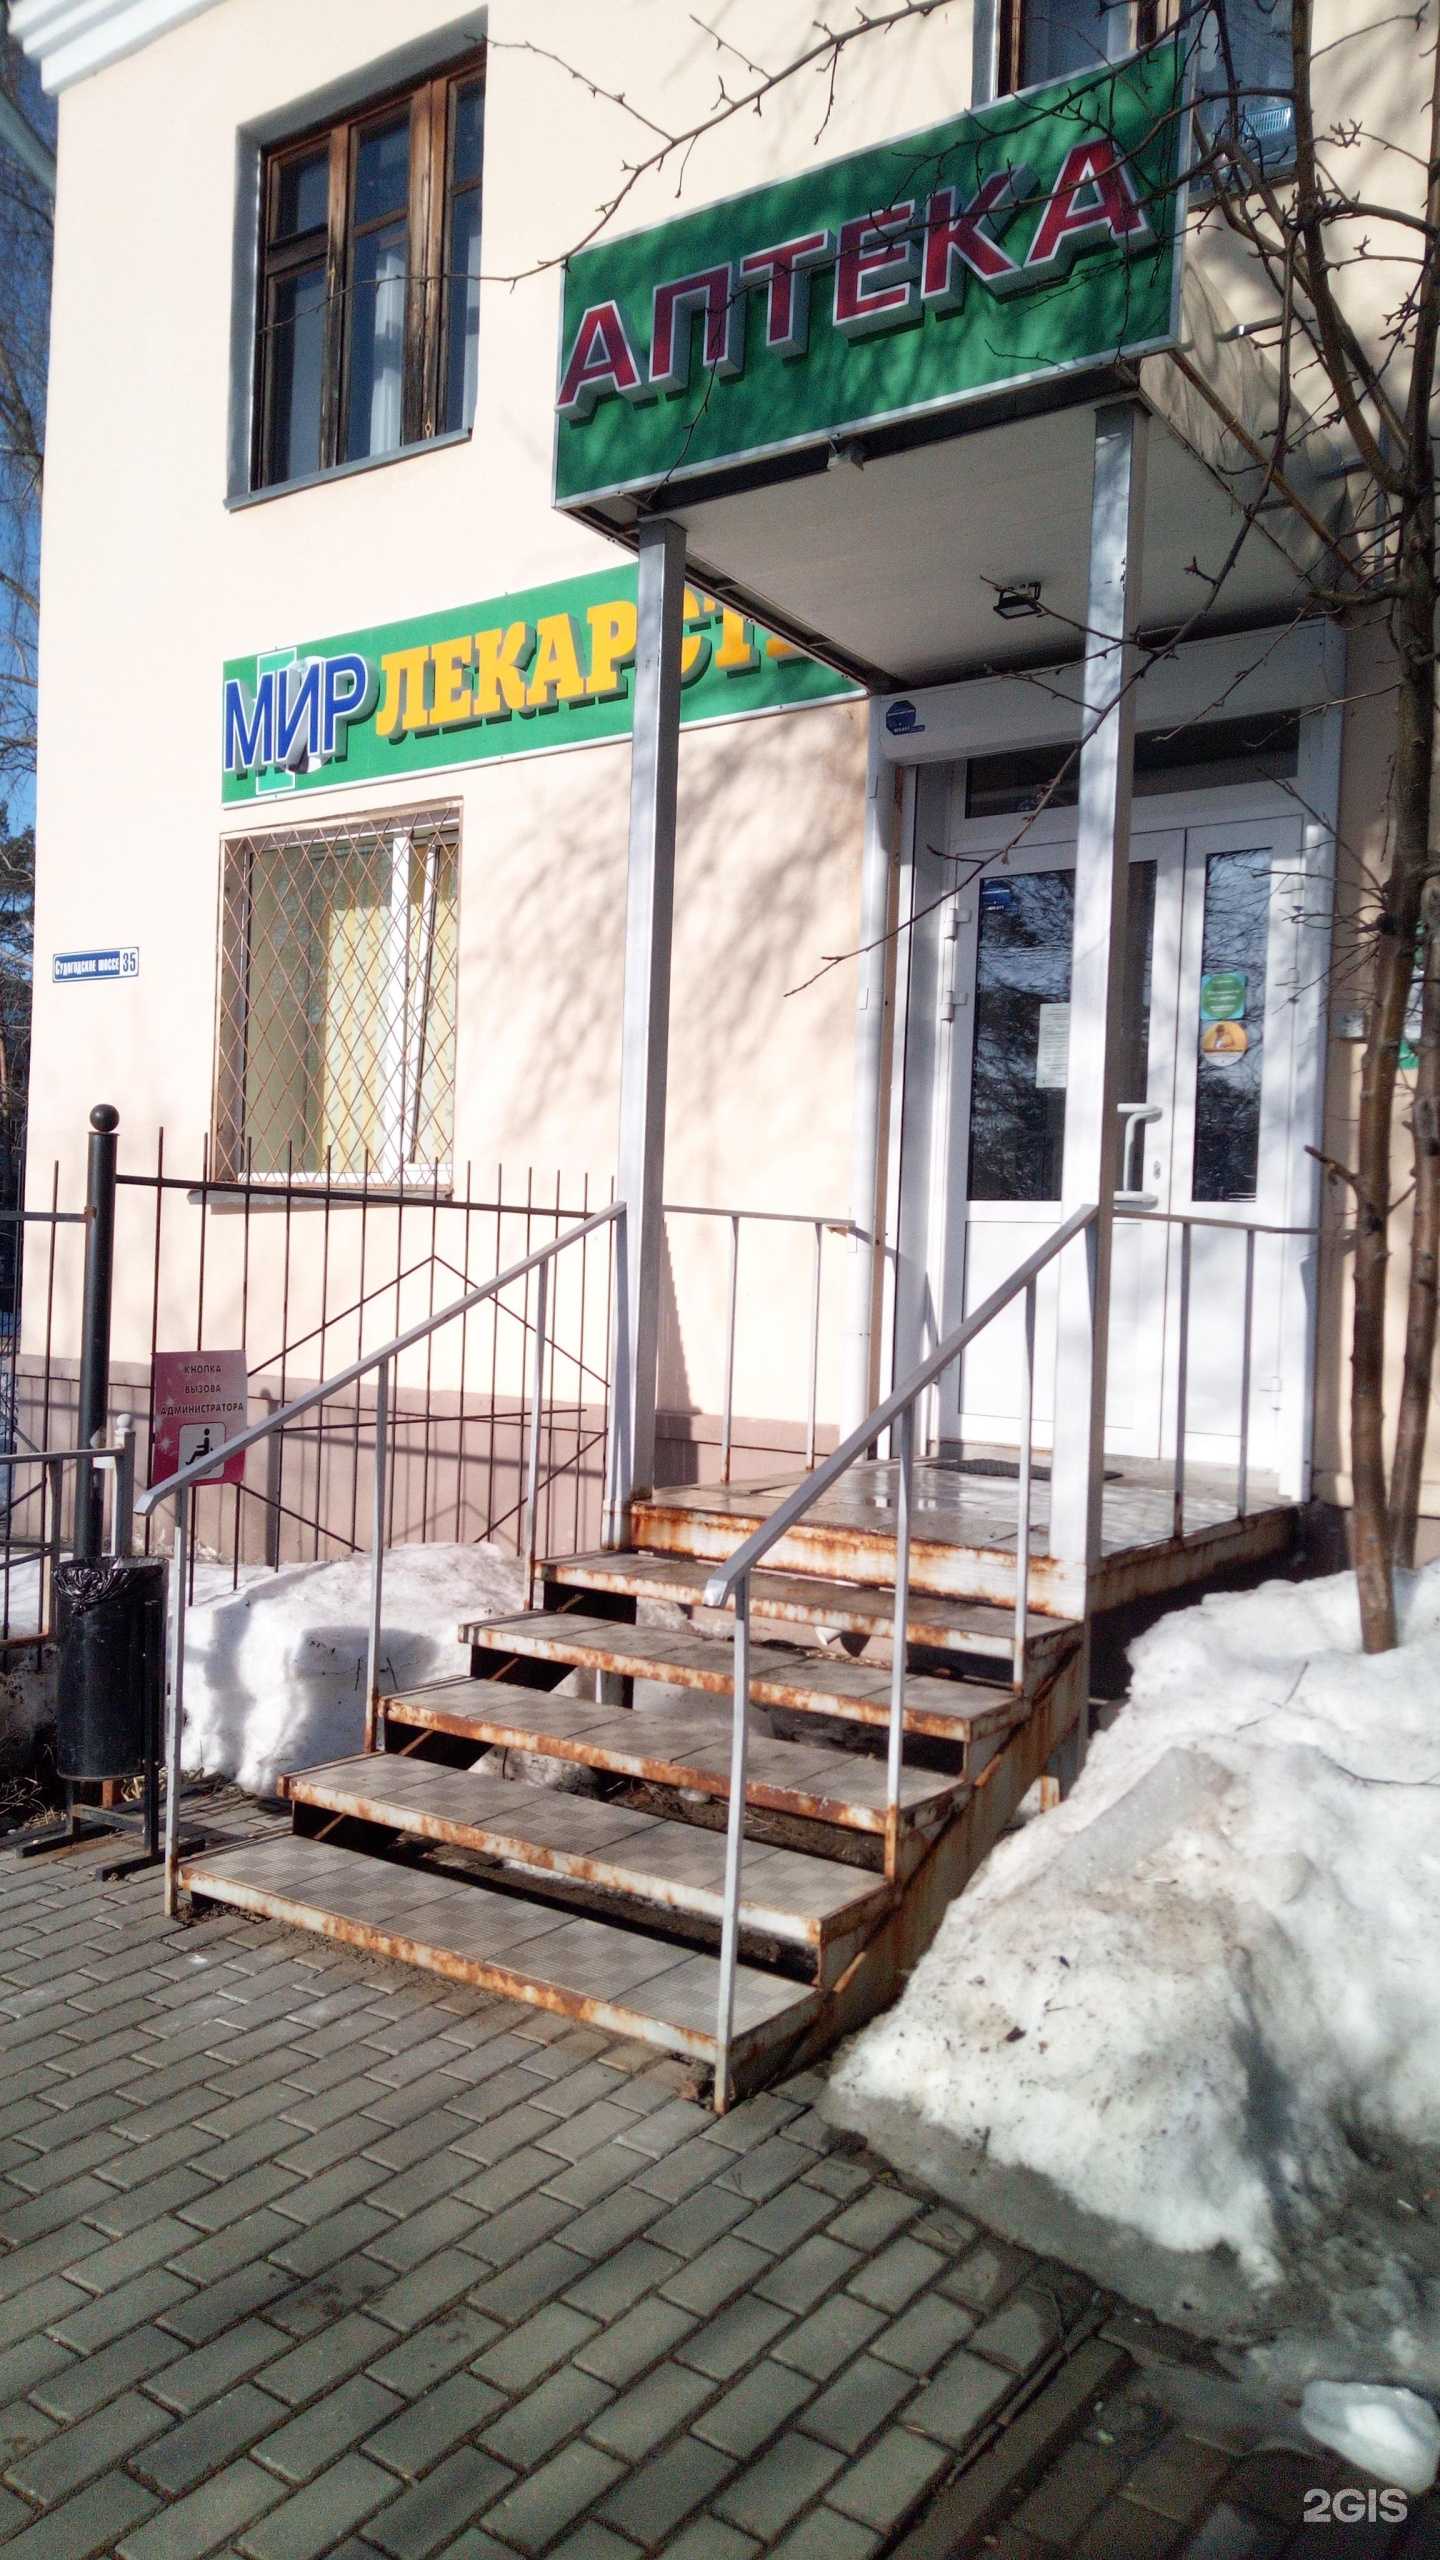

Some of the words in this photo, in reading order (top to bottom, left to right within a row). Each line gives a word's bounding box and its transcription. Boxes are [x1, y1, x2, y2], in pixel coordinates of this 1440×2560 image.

[555, 138, 1152, 413] АПТЕКА
[223, 656, 369, 771] МИР
[375, 587, 803, 738] ЛЕКАРТ
[122, 952, 136, 972] 35
[184, 1364, 222, 1374] КНОПКА
[184, 1384, 222, 1394] ВЫЗОВА
[160, 1402, 244, 1416] АДМИНИСТРАТОРА
